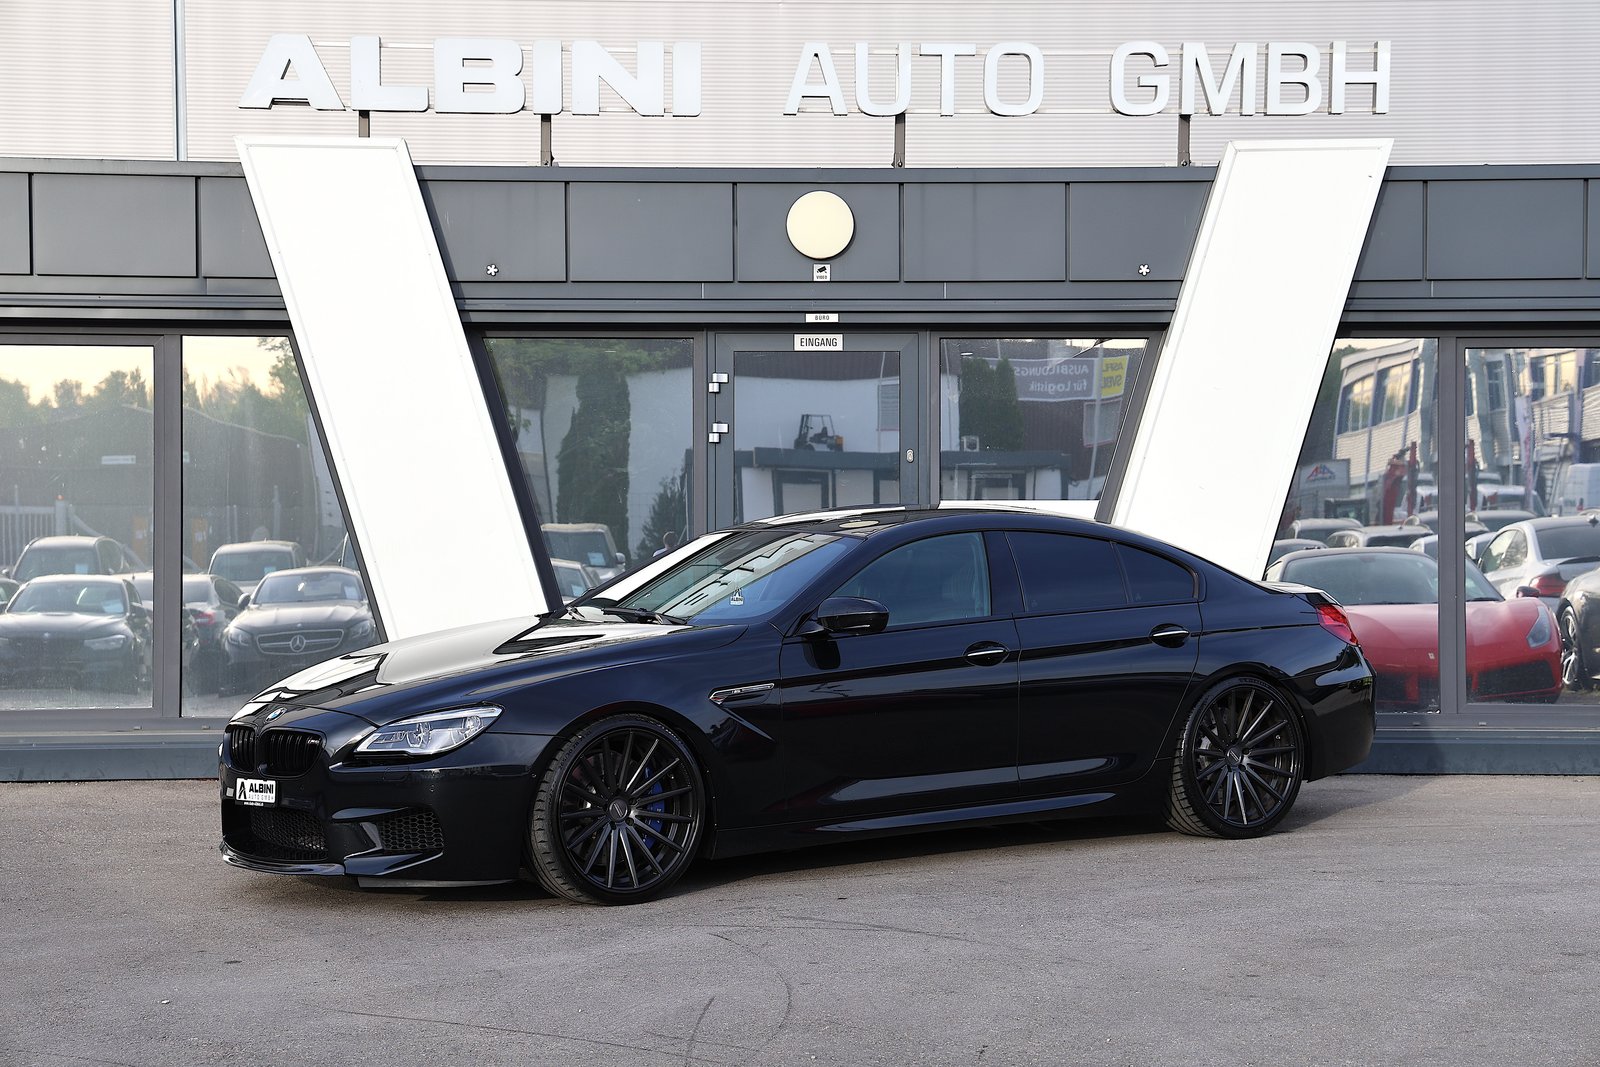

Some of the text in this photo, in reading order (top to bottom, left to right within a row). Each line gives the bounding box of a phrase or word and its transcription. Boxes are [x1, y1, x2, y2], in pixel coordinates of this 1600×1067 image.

[238, 33, 1392, 117] ALBINI AUTO GMBH
[800, 337, 838, 347] EINGANG
[248, 782, 274, 794] ALBINI
